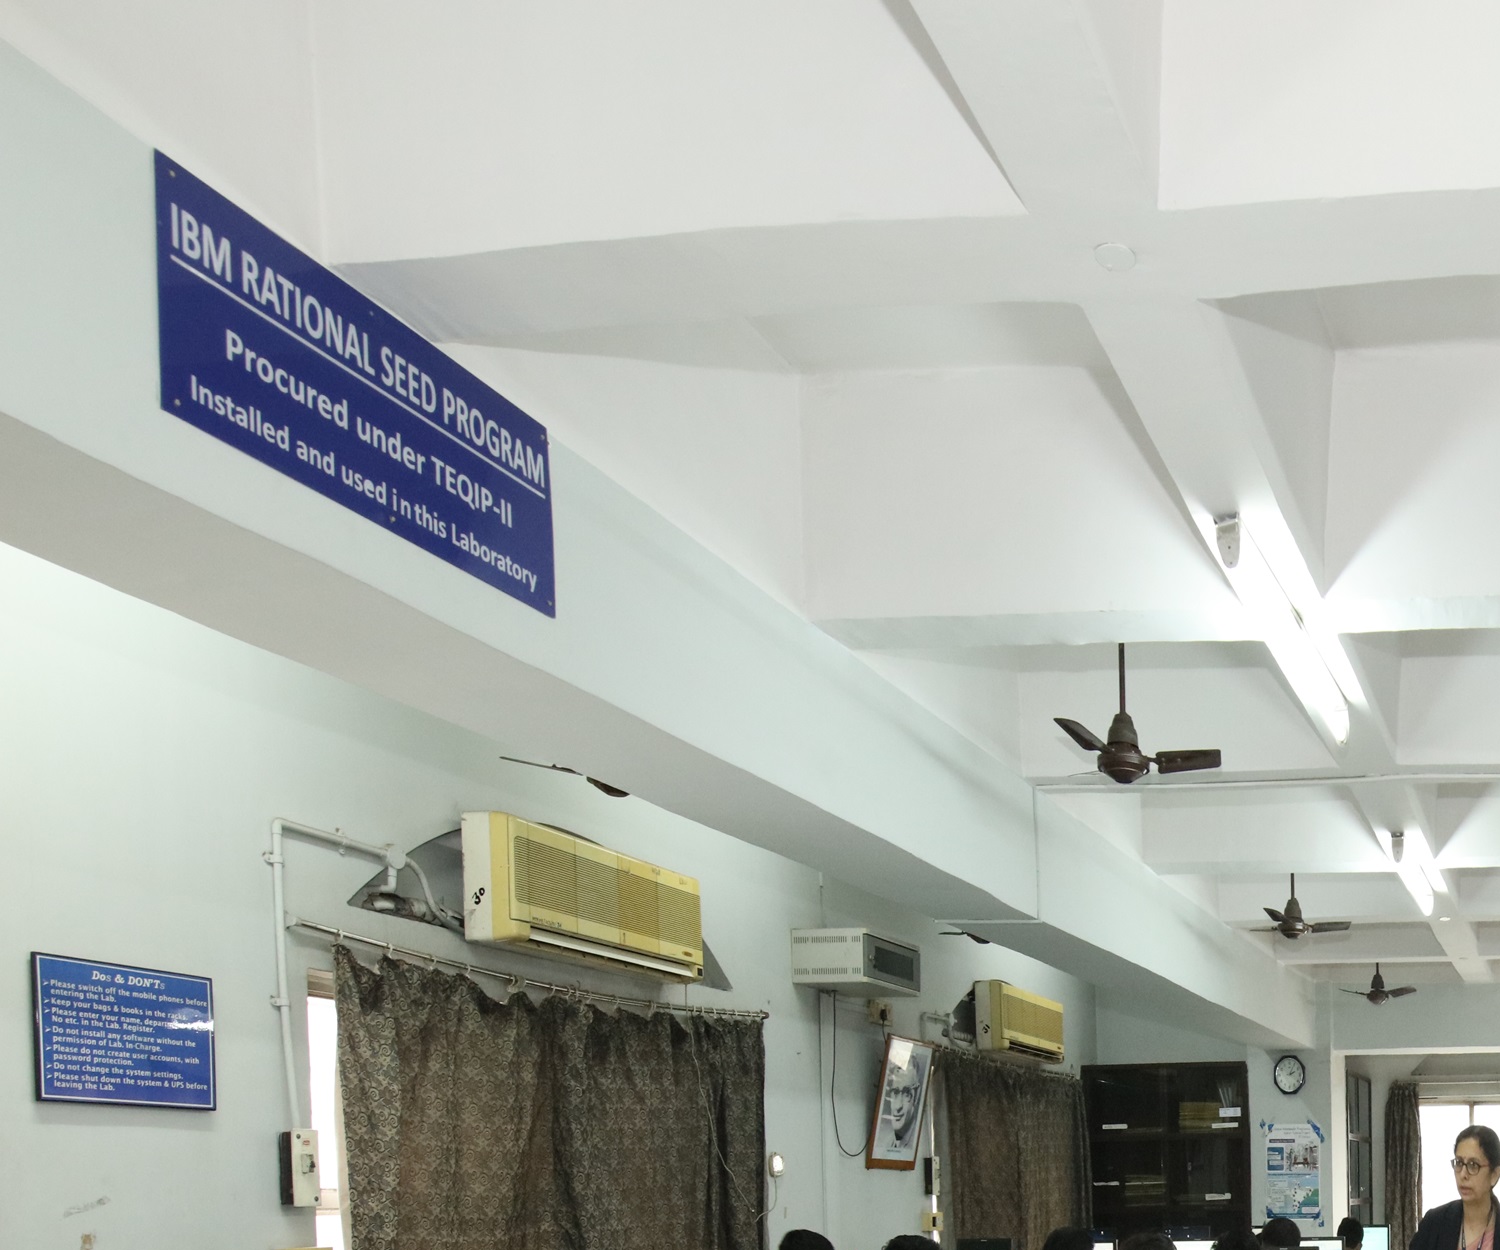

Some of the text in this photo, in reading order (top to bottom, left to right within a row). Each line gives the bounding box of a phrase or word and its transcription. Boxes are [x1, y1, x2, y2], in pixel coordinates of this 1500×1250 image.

[171, 202, 545, 488] IBM RATIONAL SEED PROGRAM
[226, 329, 512, 528] Procured under TEQIP-II
[191, 375, 289, 451] Installed
[297, 440, 335, 476] and
[341, 465, 387, 506] used
[414, 503, 447, 538] this
[452, 523, 537, 593] Laboratory
[91, 970, 112, 982] Dos
[114, 974, 125, 984] &
[50, 979, 208, 1007] Please switch off the mobile phones before
[50, 988, 117, 1003] entering the Lab.
[51, 997, 71, 1007] Keep
[73, 1001, 91, 1009] your
[93, 1002, 111, 1012] bags
[121, 1006, 143, 1015] books
[154, 1010, 166, 1018] the
[51, 1007, 77, 1017] Please
[79, 1011, 100, 1019] enter
[101, 1014, 119, 1022] your
[52, 1015, 63, 1023] No
[65, 1017, 79, 1025] etc.
[91, 1019, 103, 1027] the
[105, 1021, 121, 1029] Lab.
[123, 1023, 155, 1033] Register.
[52, 1025, 64, 1034] Do
[81, 1029, 105, 1038] install
[123, 1034, 154, 1043] software
[156, 1037, 183, 1047] without
[185, 1040, 196, 1048] the
[52, 1035, 97, 1045] permission
[108, 1040, 124, 1048] Lab.
[53, 1044, 78, 1053] Please
[80, 1046, 90, 1054] do
[93, 1048, 105, 1056] not
[107, 1050, 130, 1058] create
[53, 1053, 134, 1066] password protection.
[53, 1062, 65, 1070] Do
[82, 1064, 110, 1074] change
[111, 1067, 124, 1075] the
[125, 1069, 151, 1077] system
[153, 1071, 183, 1080] settings.
[53, 1072, 208, 1090] Please shut down the system & UPS before
[54, 1080, 115, 1091] leaving the Lab.
